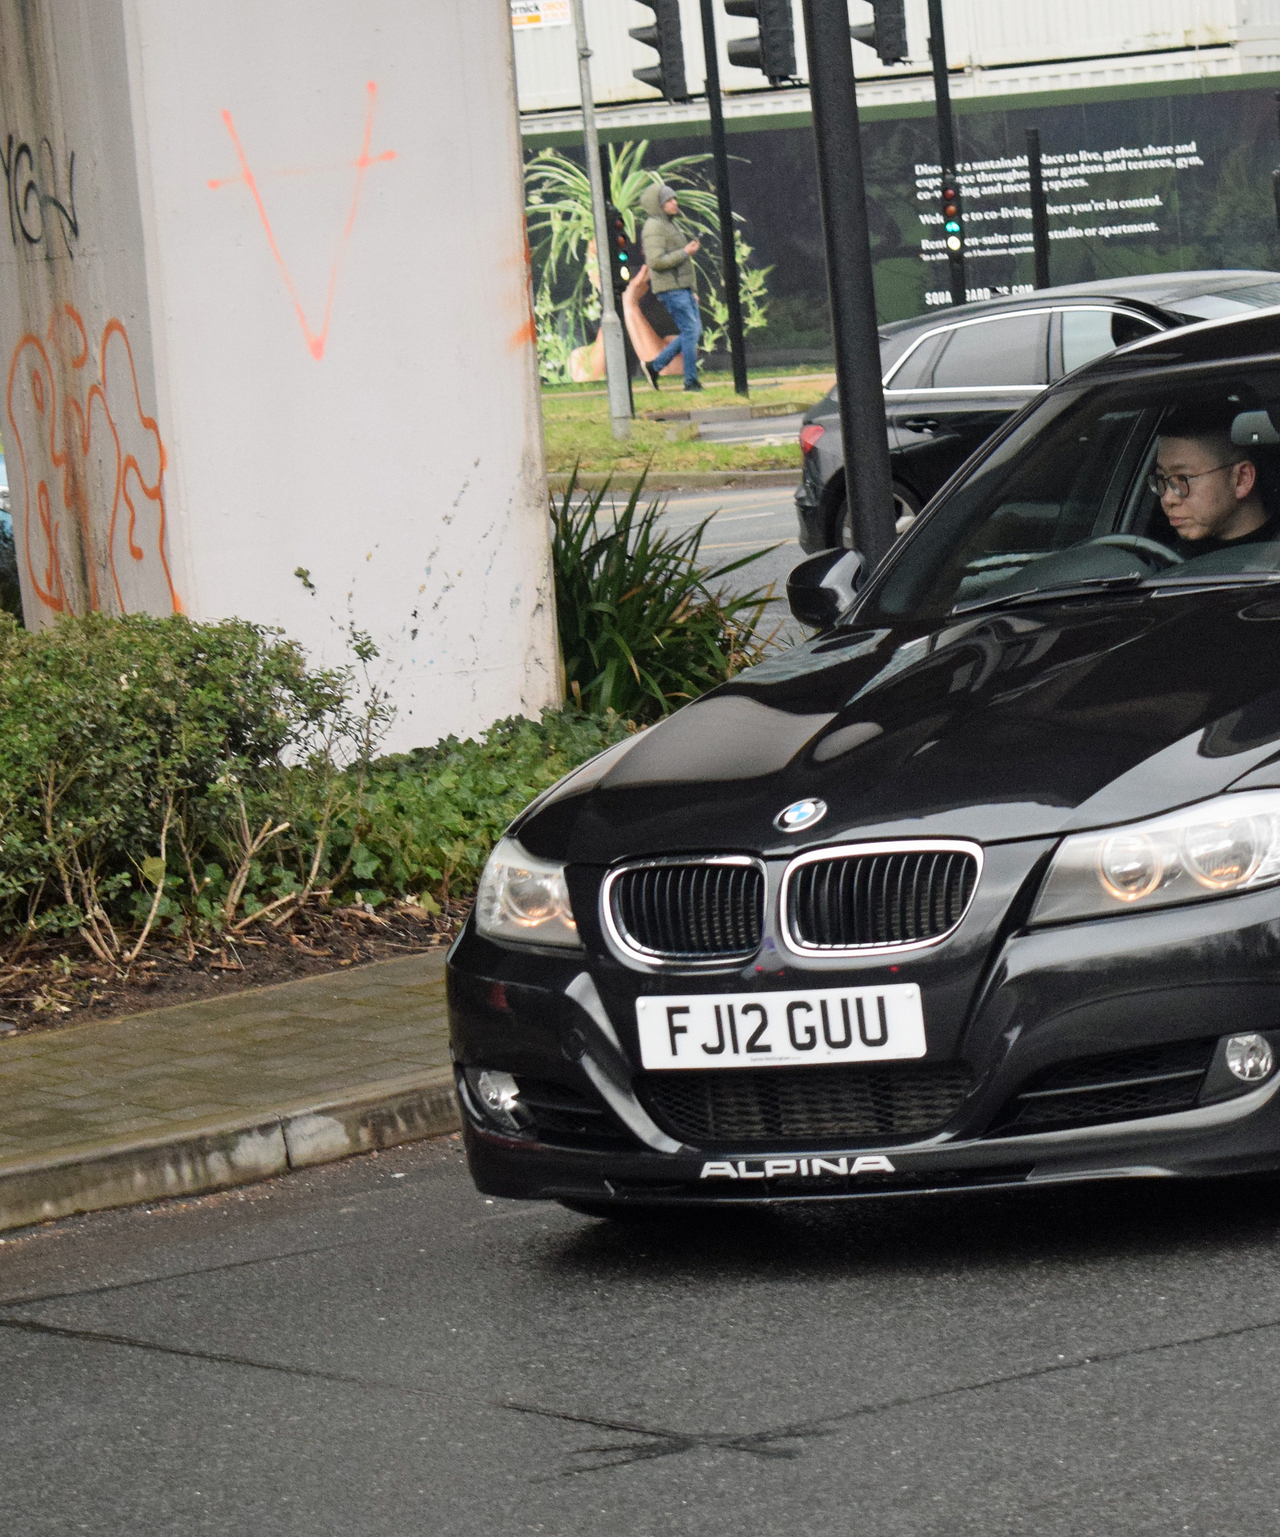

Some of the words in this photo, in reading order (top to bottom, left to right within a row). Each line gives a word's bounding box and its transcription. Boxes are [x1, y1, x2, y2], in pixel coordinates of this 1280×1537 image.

[971, 155, 1029, 171] sustainabl
[1065, 153, 1079, 163] to
[1142, 144, 1174, 157] share
[1174, 141, 1197, 154] and
[975, 169, 1031, 183] throughou
[1060, 163, 1104, 179] gardens
[1104, 160, 1127, 172] and
[980, 182, 1002, 195] and
[970, 211, 984, 221] to
[1046, 203, 1071, 215] here
[1105, 198, 1119, 210] in
[1048, 226, 1084, 240] studio
[1084, 227, 1097, 237] or
[666, 1003, 772, 1057] FJ12
[786, 995, 888, 1051] GUU
[700, 1155, 896, 1179] ALPINA
